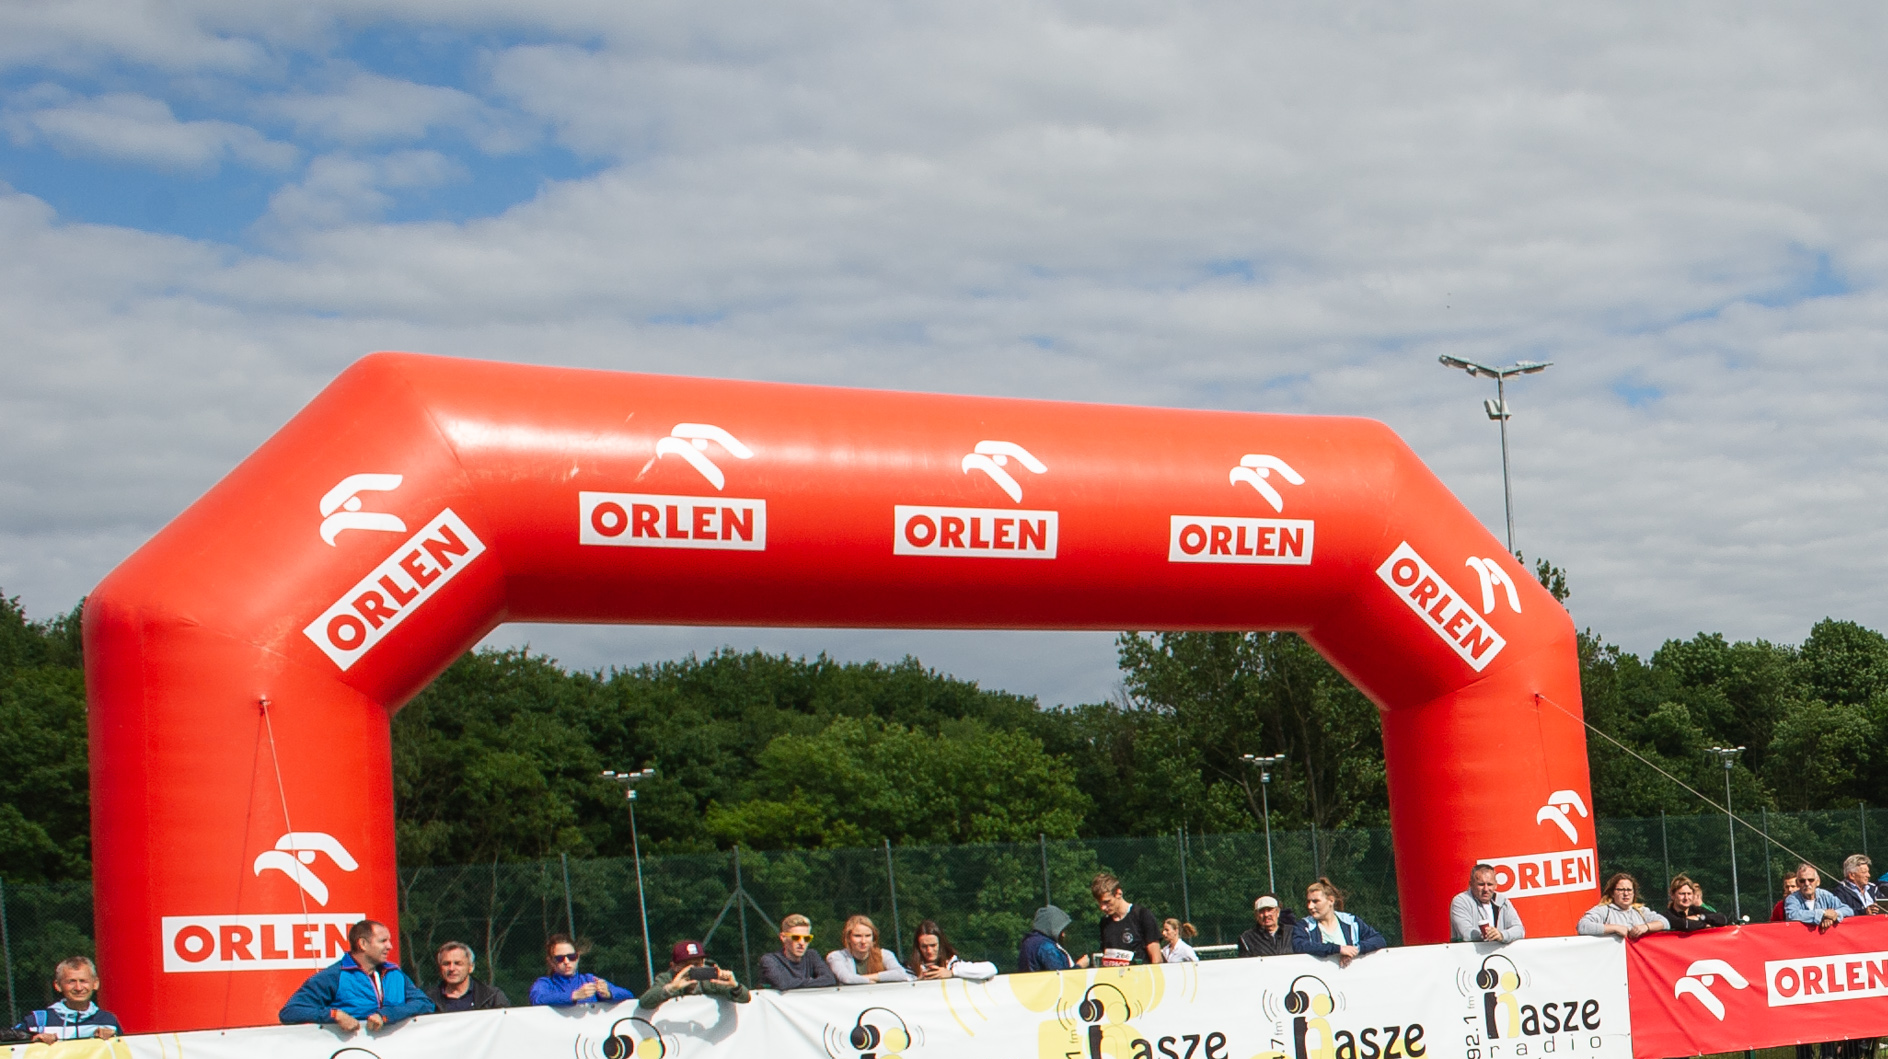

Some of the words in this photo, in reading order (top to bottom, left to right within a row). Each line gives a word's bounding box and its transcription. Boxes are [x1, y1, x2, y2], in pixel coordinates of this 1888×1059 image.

[590, 501, 755, 542] ORLEN
[904, 515, 1048, 551] ORLEN
[1178, 523, 1305, 556] ORLEN
[326, 522, 471, 652] ORLEN
[1390, 556, 1495, 660] ORLEN
[1494, 856, 1592, 893] ORLEN
[174, 923, 353, 963] ORLEN
[1489, 1033, 1602, 1059] radio
